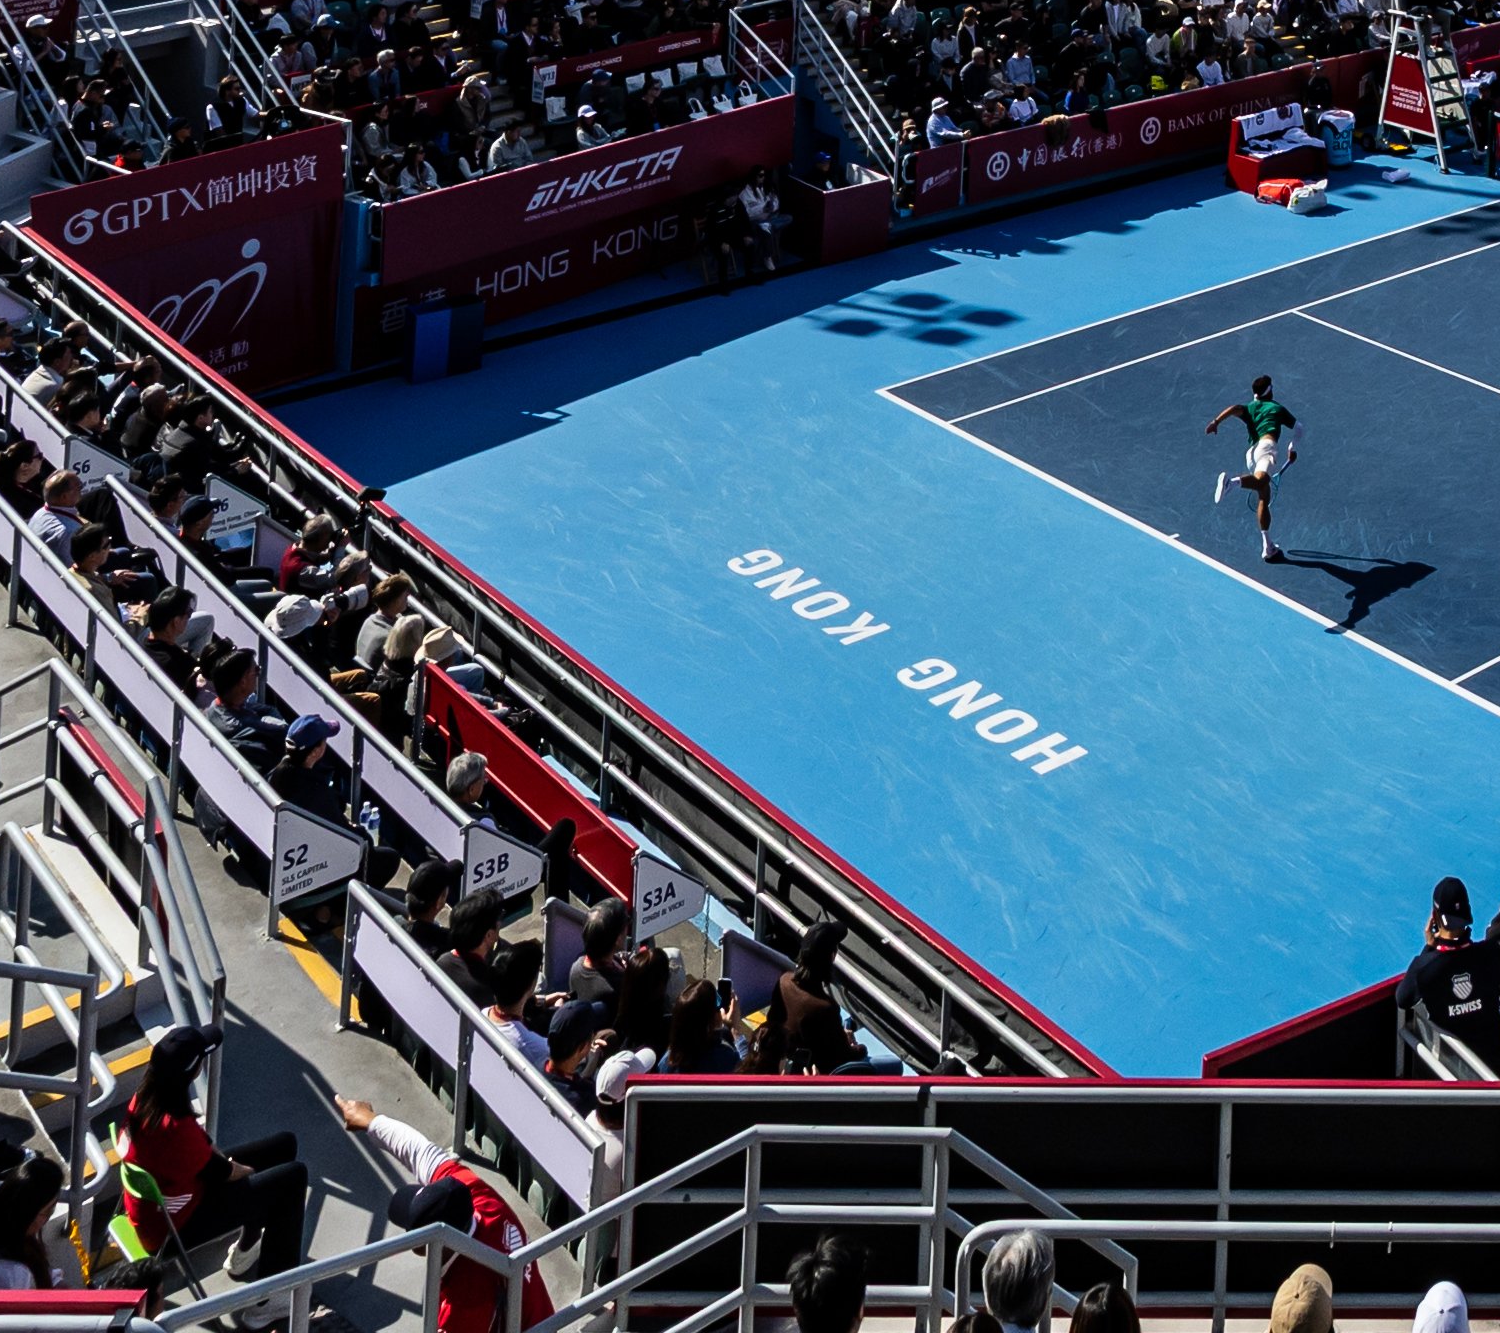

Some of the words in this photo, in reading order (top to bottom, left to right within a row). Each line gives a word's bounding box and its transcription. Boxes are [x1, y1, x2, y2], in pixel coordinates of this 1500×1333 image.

[1167, 112, 1205, 133] BANK
[1209, 107, 1227, 122] OF
[1229, 97, 1273, 119] CHINA
[476, 249, 570, 298] HONG
[591, 214, 680, 265] KONG
[71, 459, 90, 475] S6
[726, 548, 891, 646] KONG
[896, 658, 1089, 776] HONG
[282, 843, 308, 872] S2
[296, 860, 328, 881] CAPITAL
[473, 853, 510, 884] S3B
[280, 877, 313, 897] LIMITED
[643, 882, 677, 912] S3A
